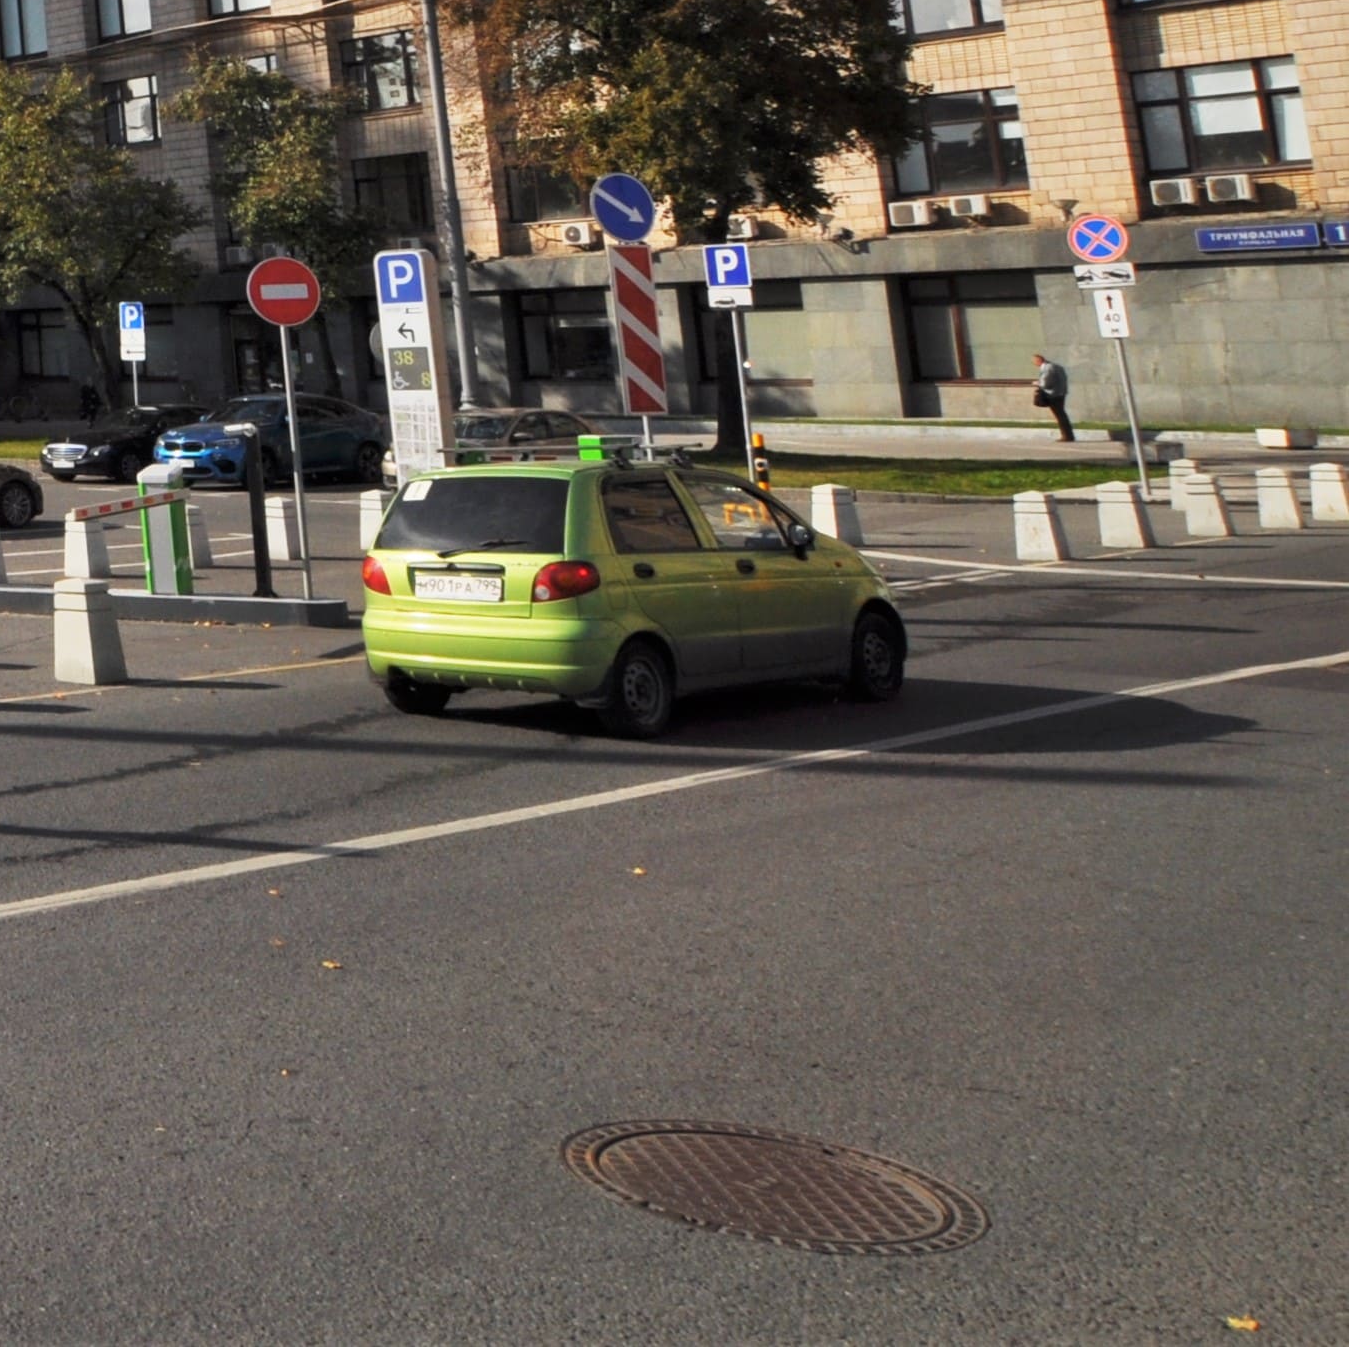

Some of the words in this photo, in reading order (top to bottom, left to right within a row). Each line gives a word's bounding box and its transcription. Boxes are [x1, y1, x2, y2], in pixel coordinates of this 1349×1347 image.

[1209, 229, 1305, 241] ТРИУМФАЛЬНАЯ
[714, 248, 739, 284] P
[387, 259, 414, 299] P
[125, 305, 139, 328] P
[1104, 313, 1120, 322] 40
[393, 350, 414, 365] 38
[421, 371, 432, 387] 8
